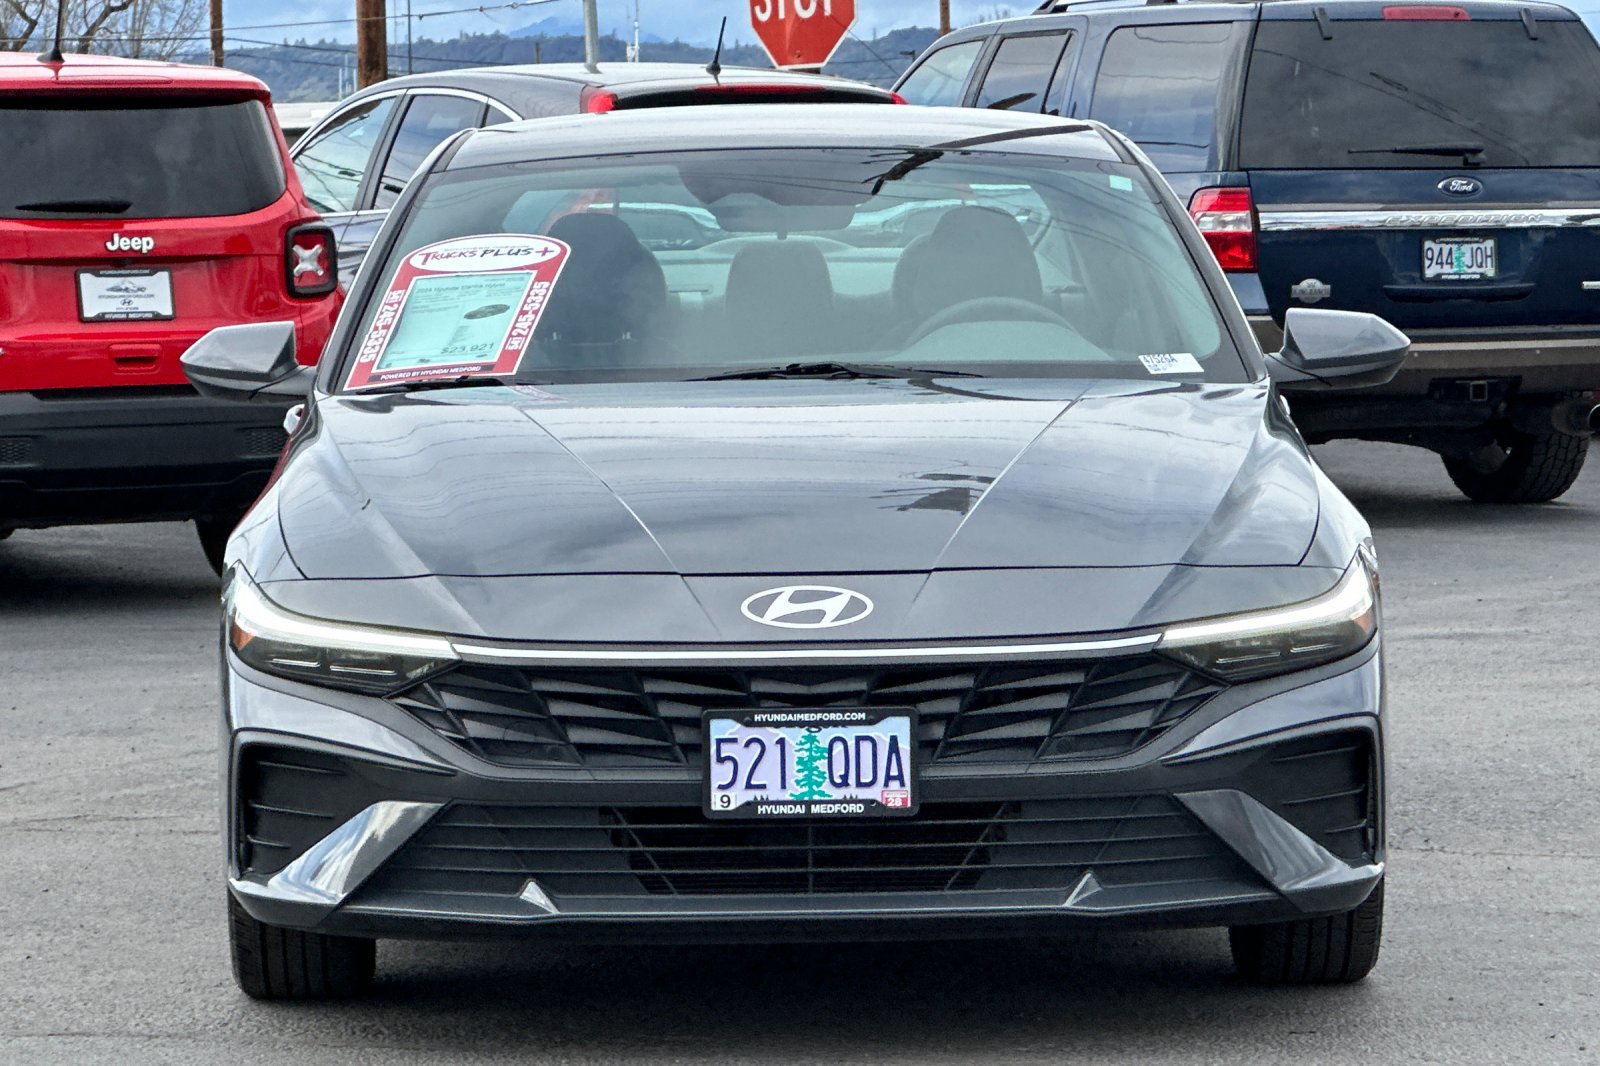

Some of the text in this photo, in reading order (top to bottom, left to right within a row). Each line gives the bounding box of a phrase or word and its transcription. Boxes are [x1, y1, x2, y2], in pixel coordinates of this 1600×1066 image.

[1450, 180, 1474, 191] Ford
[1385, 214, 1544, 226] EXPEDITION
[106, 233, 154, 253] Jeep
[419, 250, 477, 265] TRUCKS
[480, 248, 534, 257] PLUS
[1426, 246, 1494, 269] 944 JQH
[511, 281, 550, 337] 245-5335
[360, 303, 399, 363] 245-5335
[381, 372, 411, 380] POWERED
[754, 713, 866, 722] HYUNDAIMEDFORD.COM
[715, 735, 906, 790] 521 QDA
[720, 795, 731, 808] 9
[887, 798, 903, 807] 28
[757, 804, 865, 814] HYUNDAI MEDFORD
